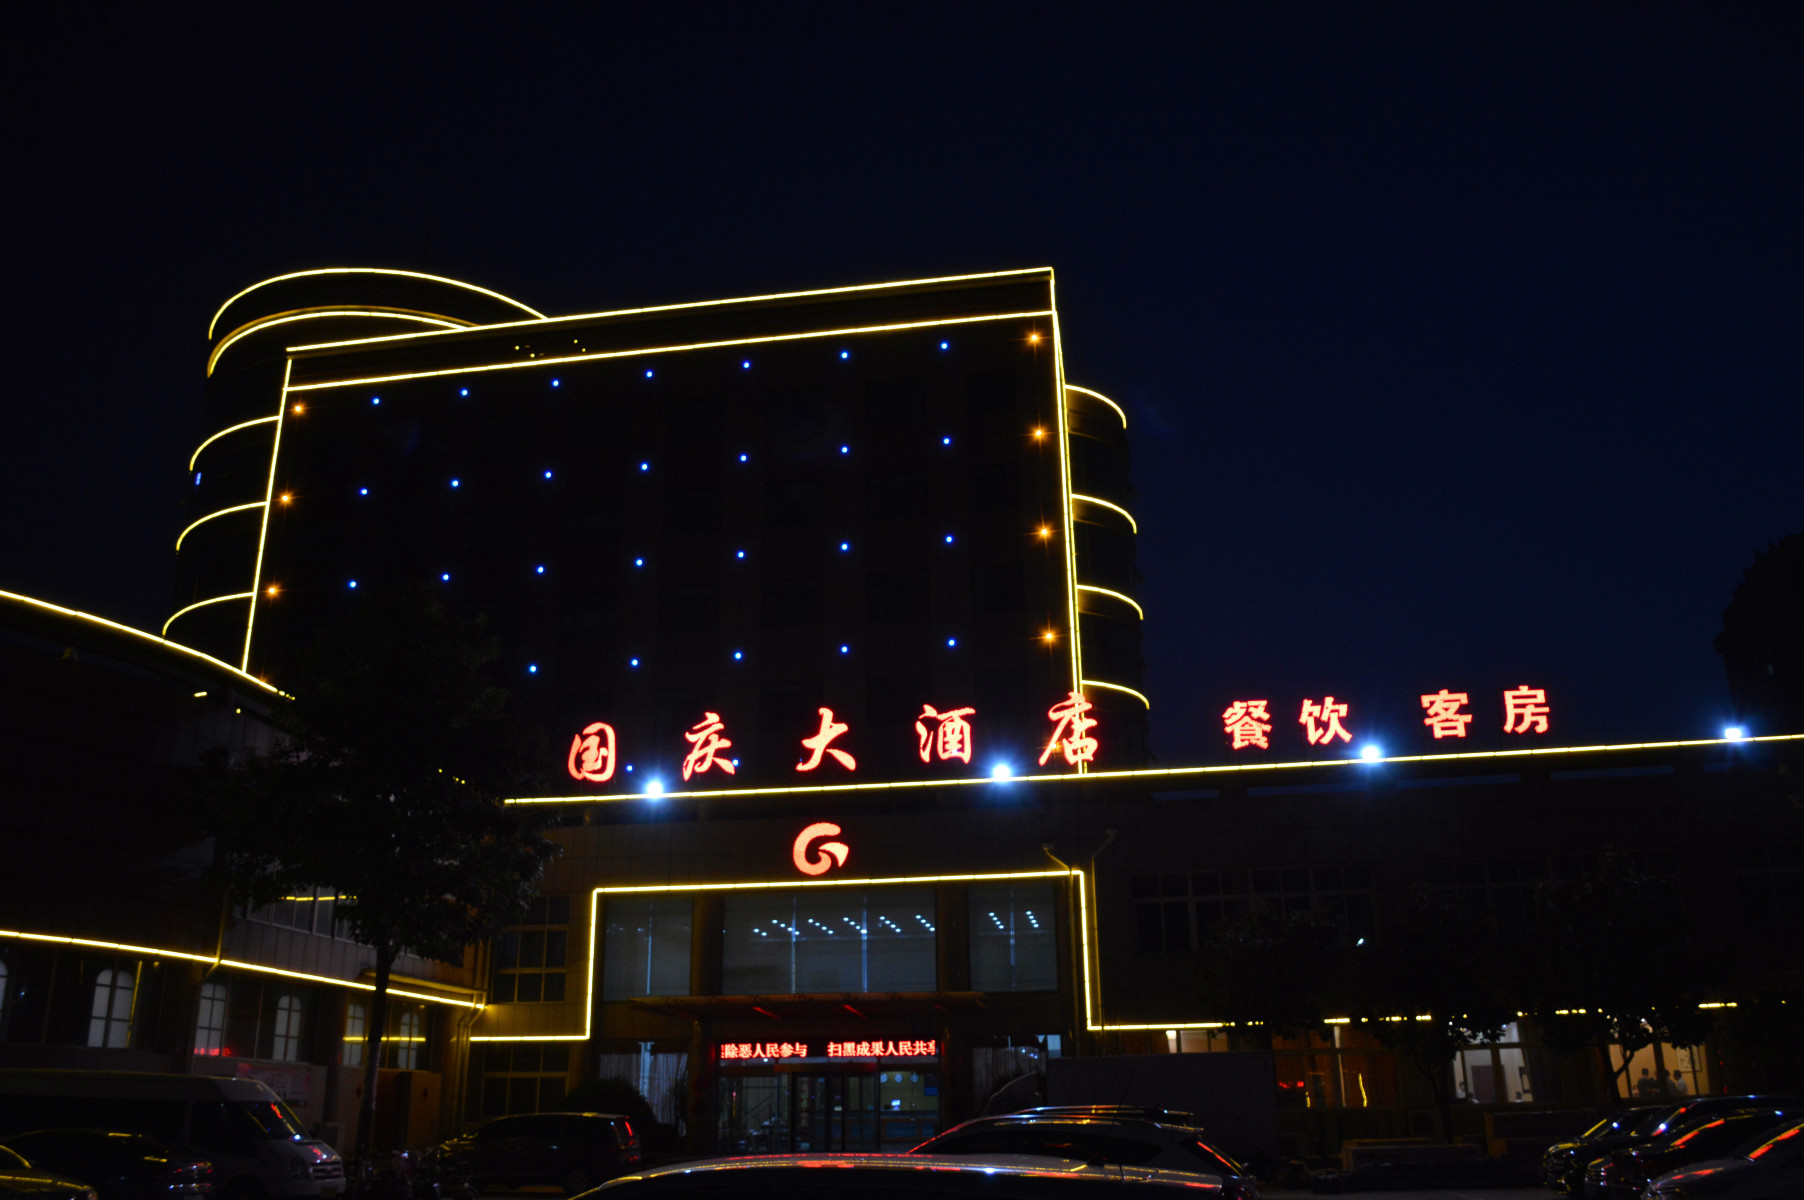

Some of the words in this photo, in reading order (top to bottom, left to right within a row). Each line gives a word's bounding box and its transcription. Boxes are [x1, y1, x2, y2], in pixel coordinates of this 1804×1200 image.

[567, 690, 1099, 782] 国庆大酒店
[1222, 696, 1352, 750] 餐饮
[1421, 685, 1550, 739] 客房
[720, 1041, 808, 1059] 除恶人民参与
